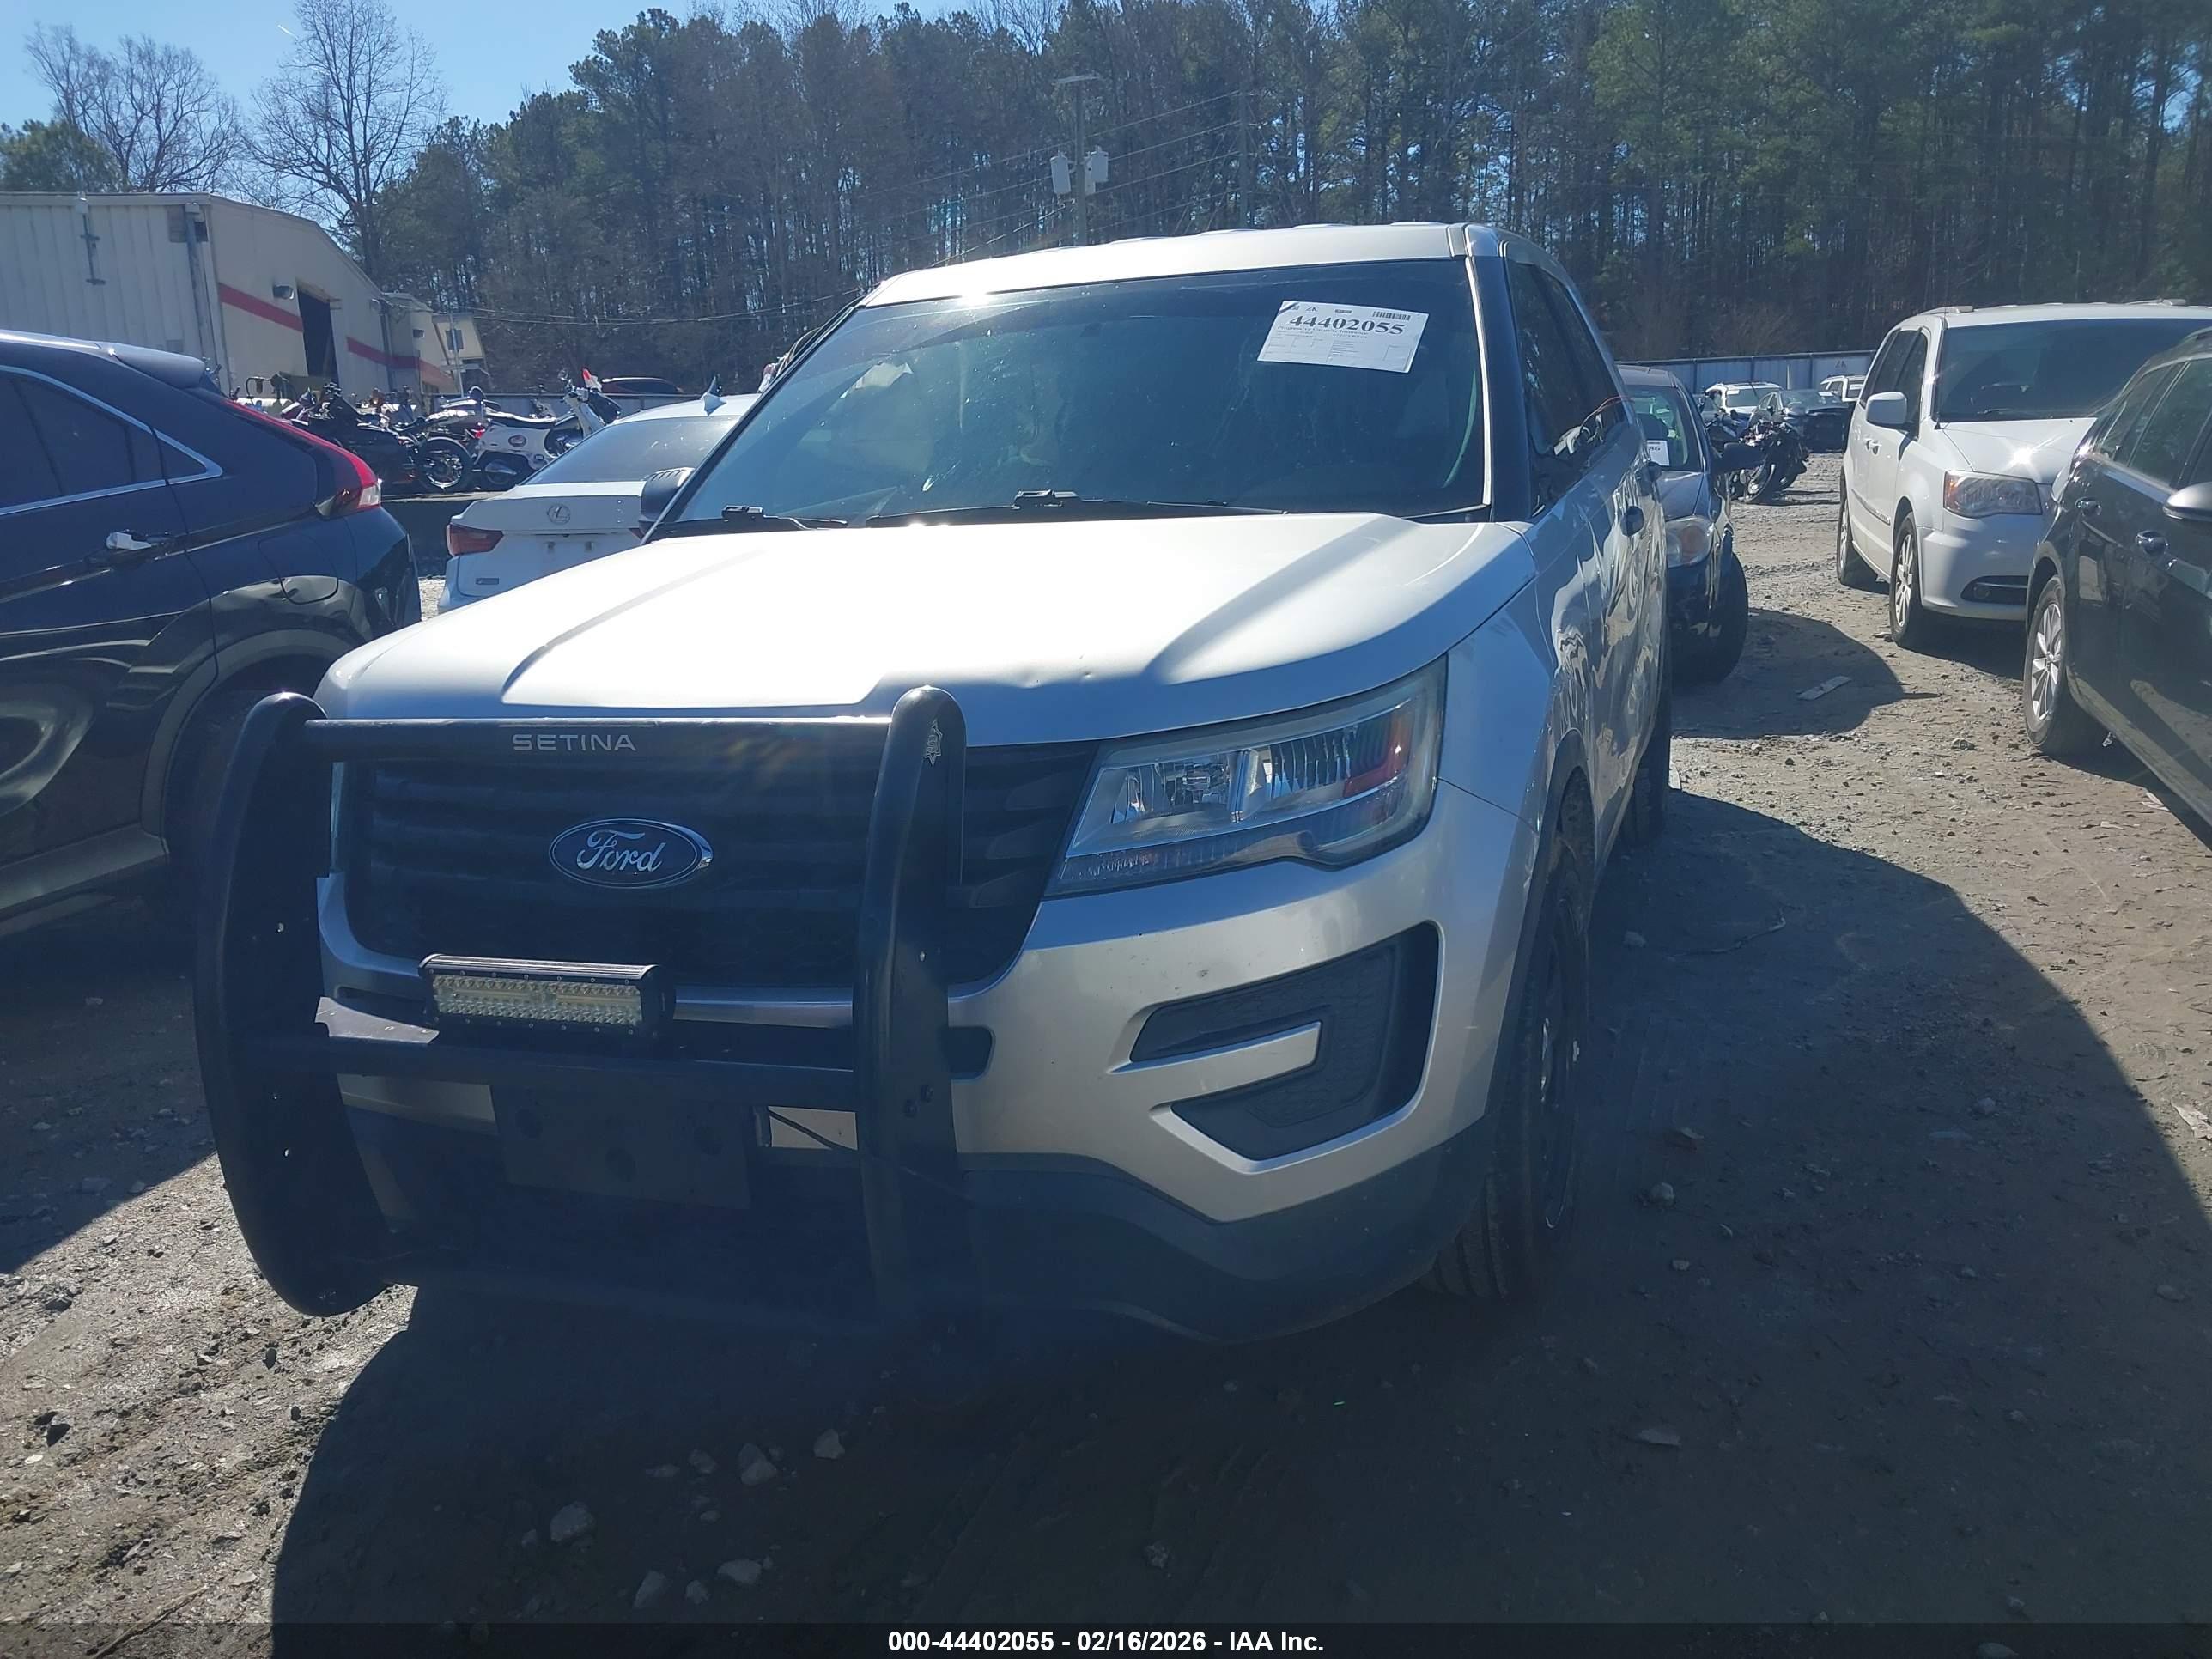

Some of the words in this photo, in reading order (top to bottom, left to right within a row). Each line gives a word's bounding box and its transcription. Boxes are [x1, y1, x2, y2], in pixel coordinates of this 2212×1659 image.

[1290, 315, 1406, 335] 44402055
[512, 734, 637, 751] SETINA
[576, 829, 666, 872] Ford
